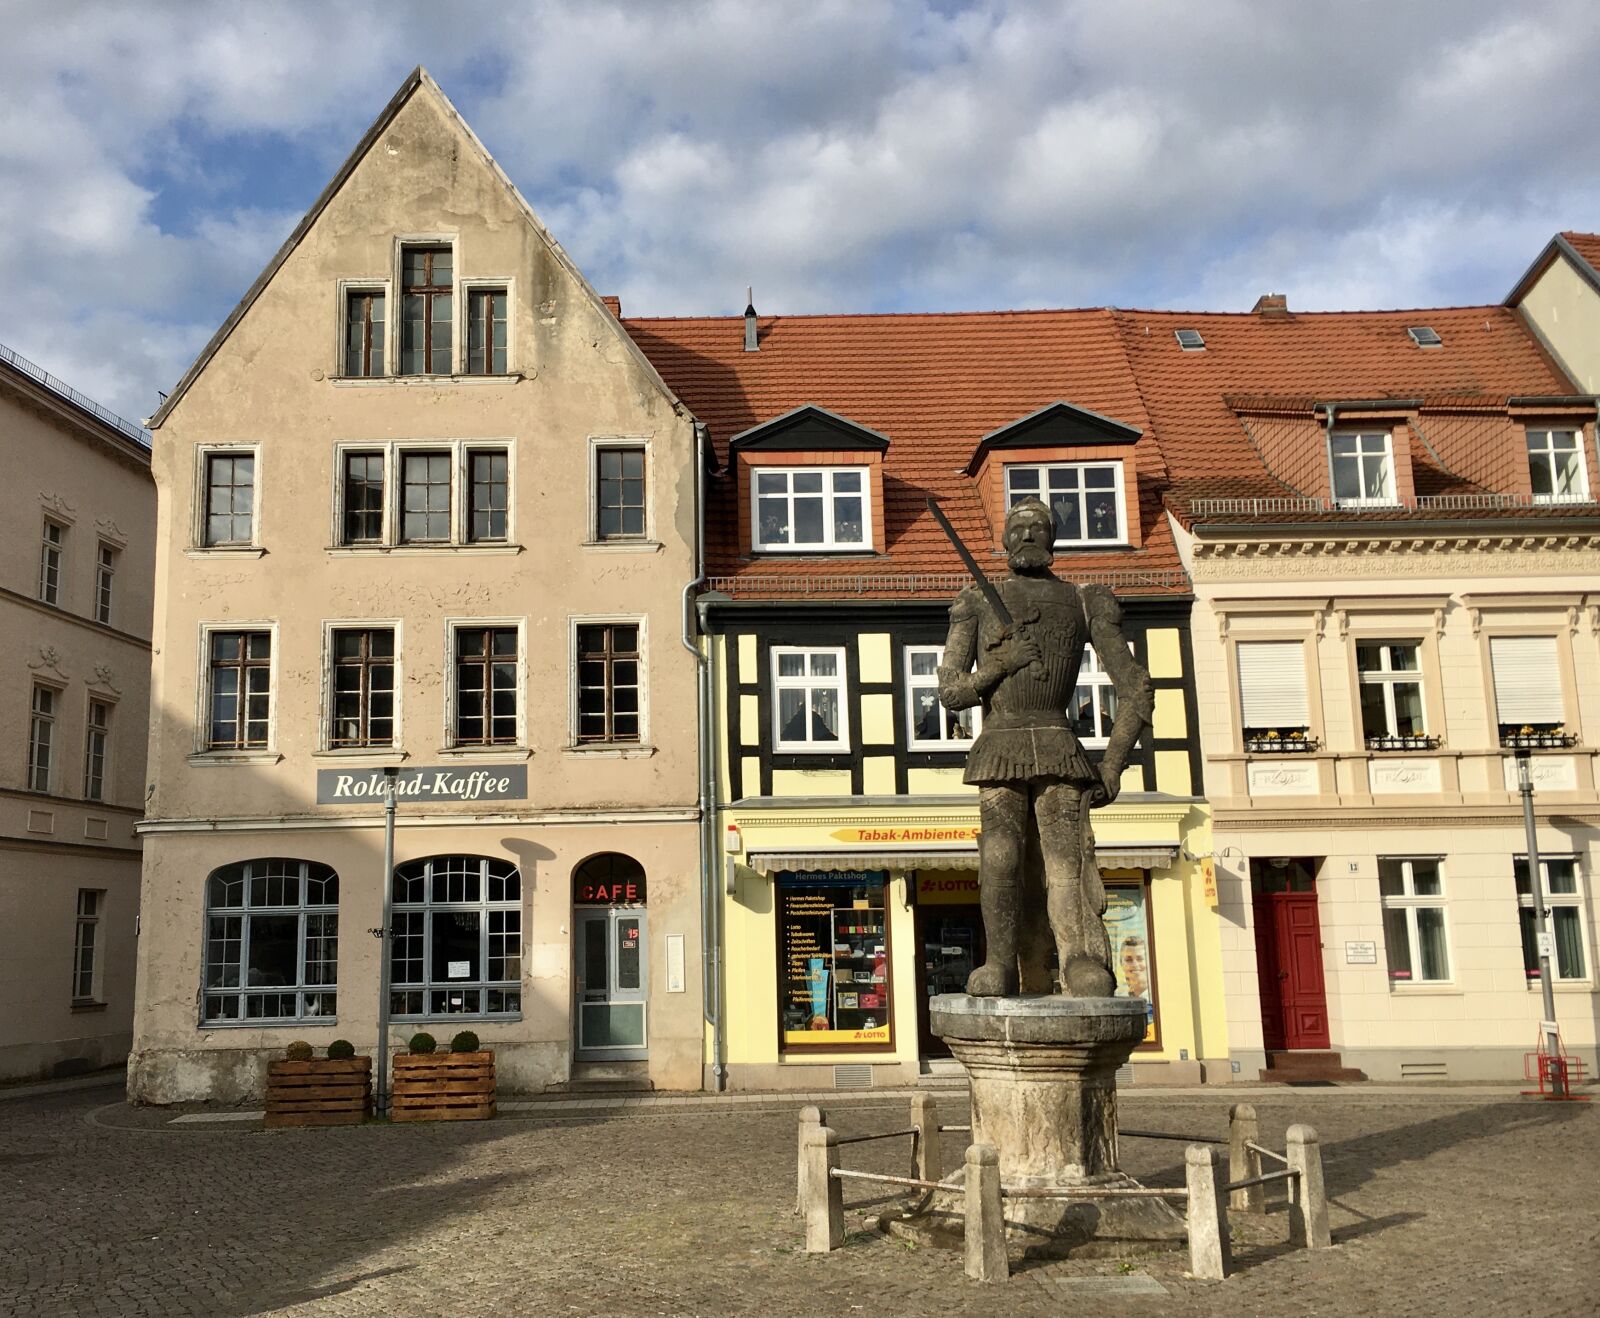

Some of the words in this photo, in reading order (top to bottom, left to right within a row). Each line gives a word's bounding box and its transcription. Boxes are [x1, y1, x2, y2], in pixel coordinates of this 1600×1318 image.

[333, 771, 510, 799] Roland-Kaffee
[828, 872, 867, 880] Paktshop
[938, 880, 979, 891] LOTTO
[627, 928, 639, 939] 15
